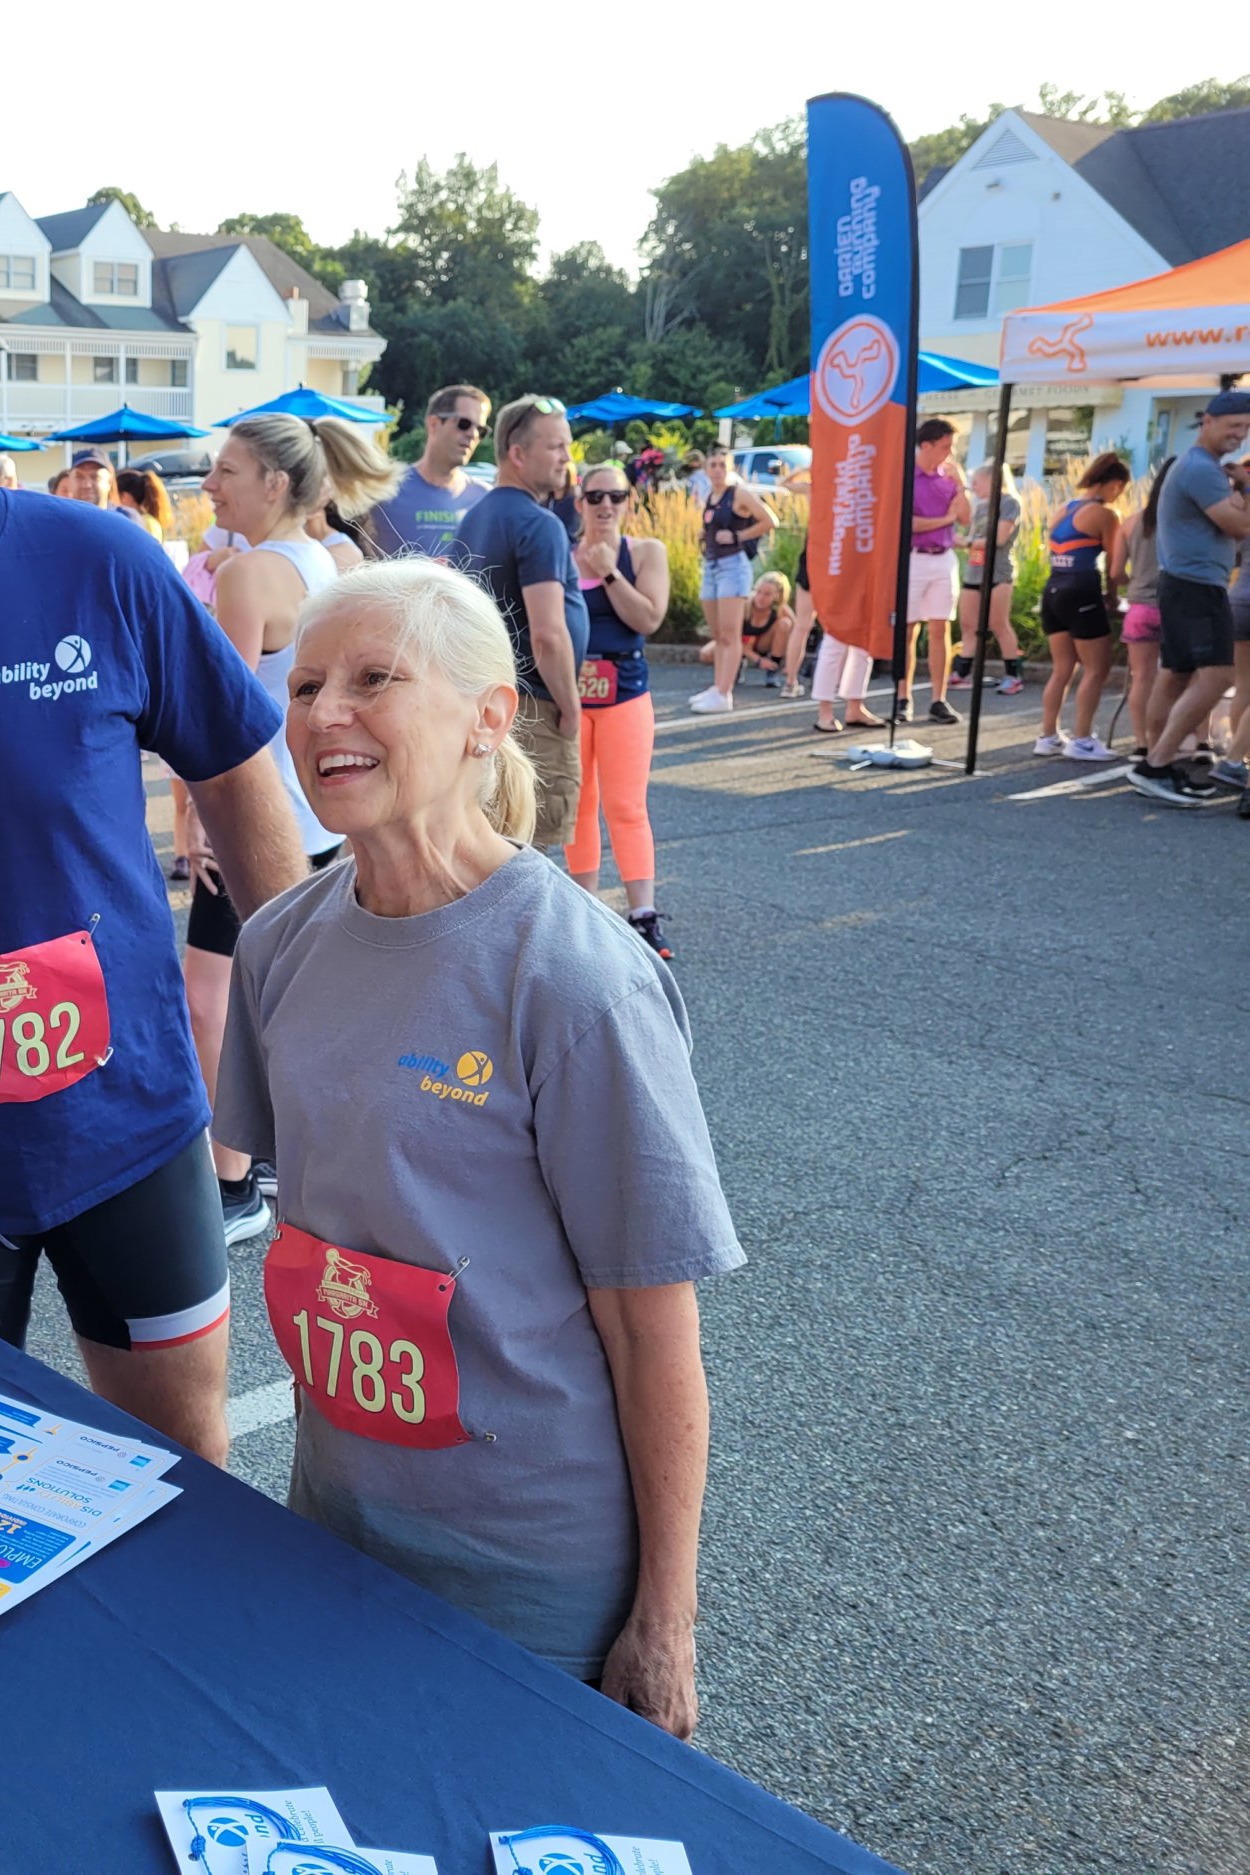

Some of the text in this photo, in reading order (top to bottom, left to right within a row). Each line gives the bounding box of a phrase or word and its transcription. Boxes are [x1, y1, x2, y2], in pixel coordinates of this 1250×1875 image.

[30, 670, 98, 701] beyond
[398, 1052, 450, 1079] ability
[420, 1074, 490, 1107] beyond
[293, 1309, 426, 1425] 1783
[79, 1436, 120, 1451] PEPSICO
[55, 1460, 98, 1475] PEPSICO
[26, 1477, 92, 1503] SOLUTIONS
